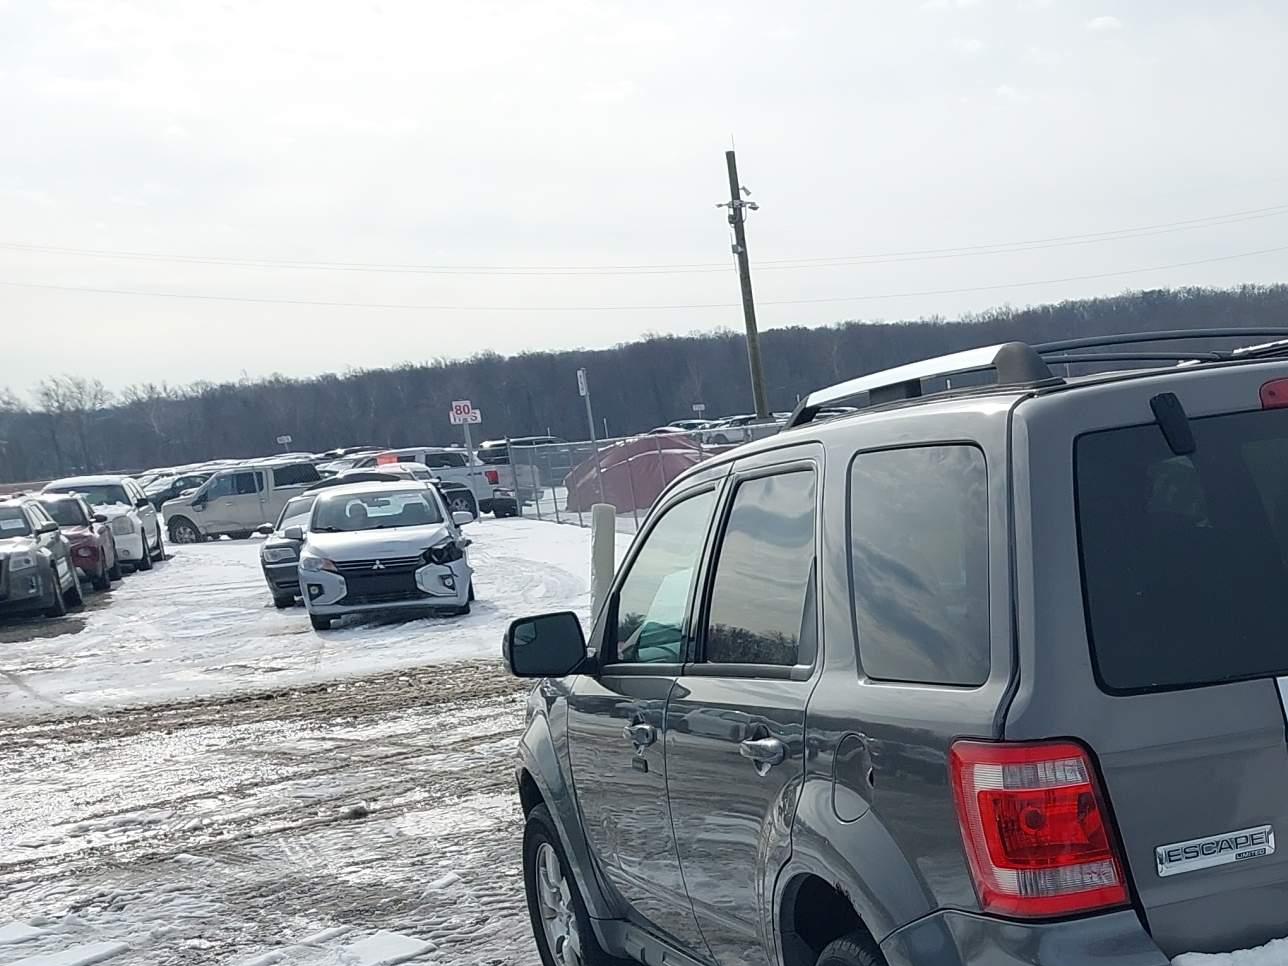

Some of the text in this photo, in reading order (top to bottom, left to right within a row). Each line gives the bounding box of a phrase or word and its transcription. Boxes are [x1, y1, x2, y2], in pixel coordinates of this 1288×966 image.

[454, 404, 471, 416] 80
[1167, 831, 1266, 863] ESCAPE
[1235, 847, 1267, 860] LIMITED
